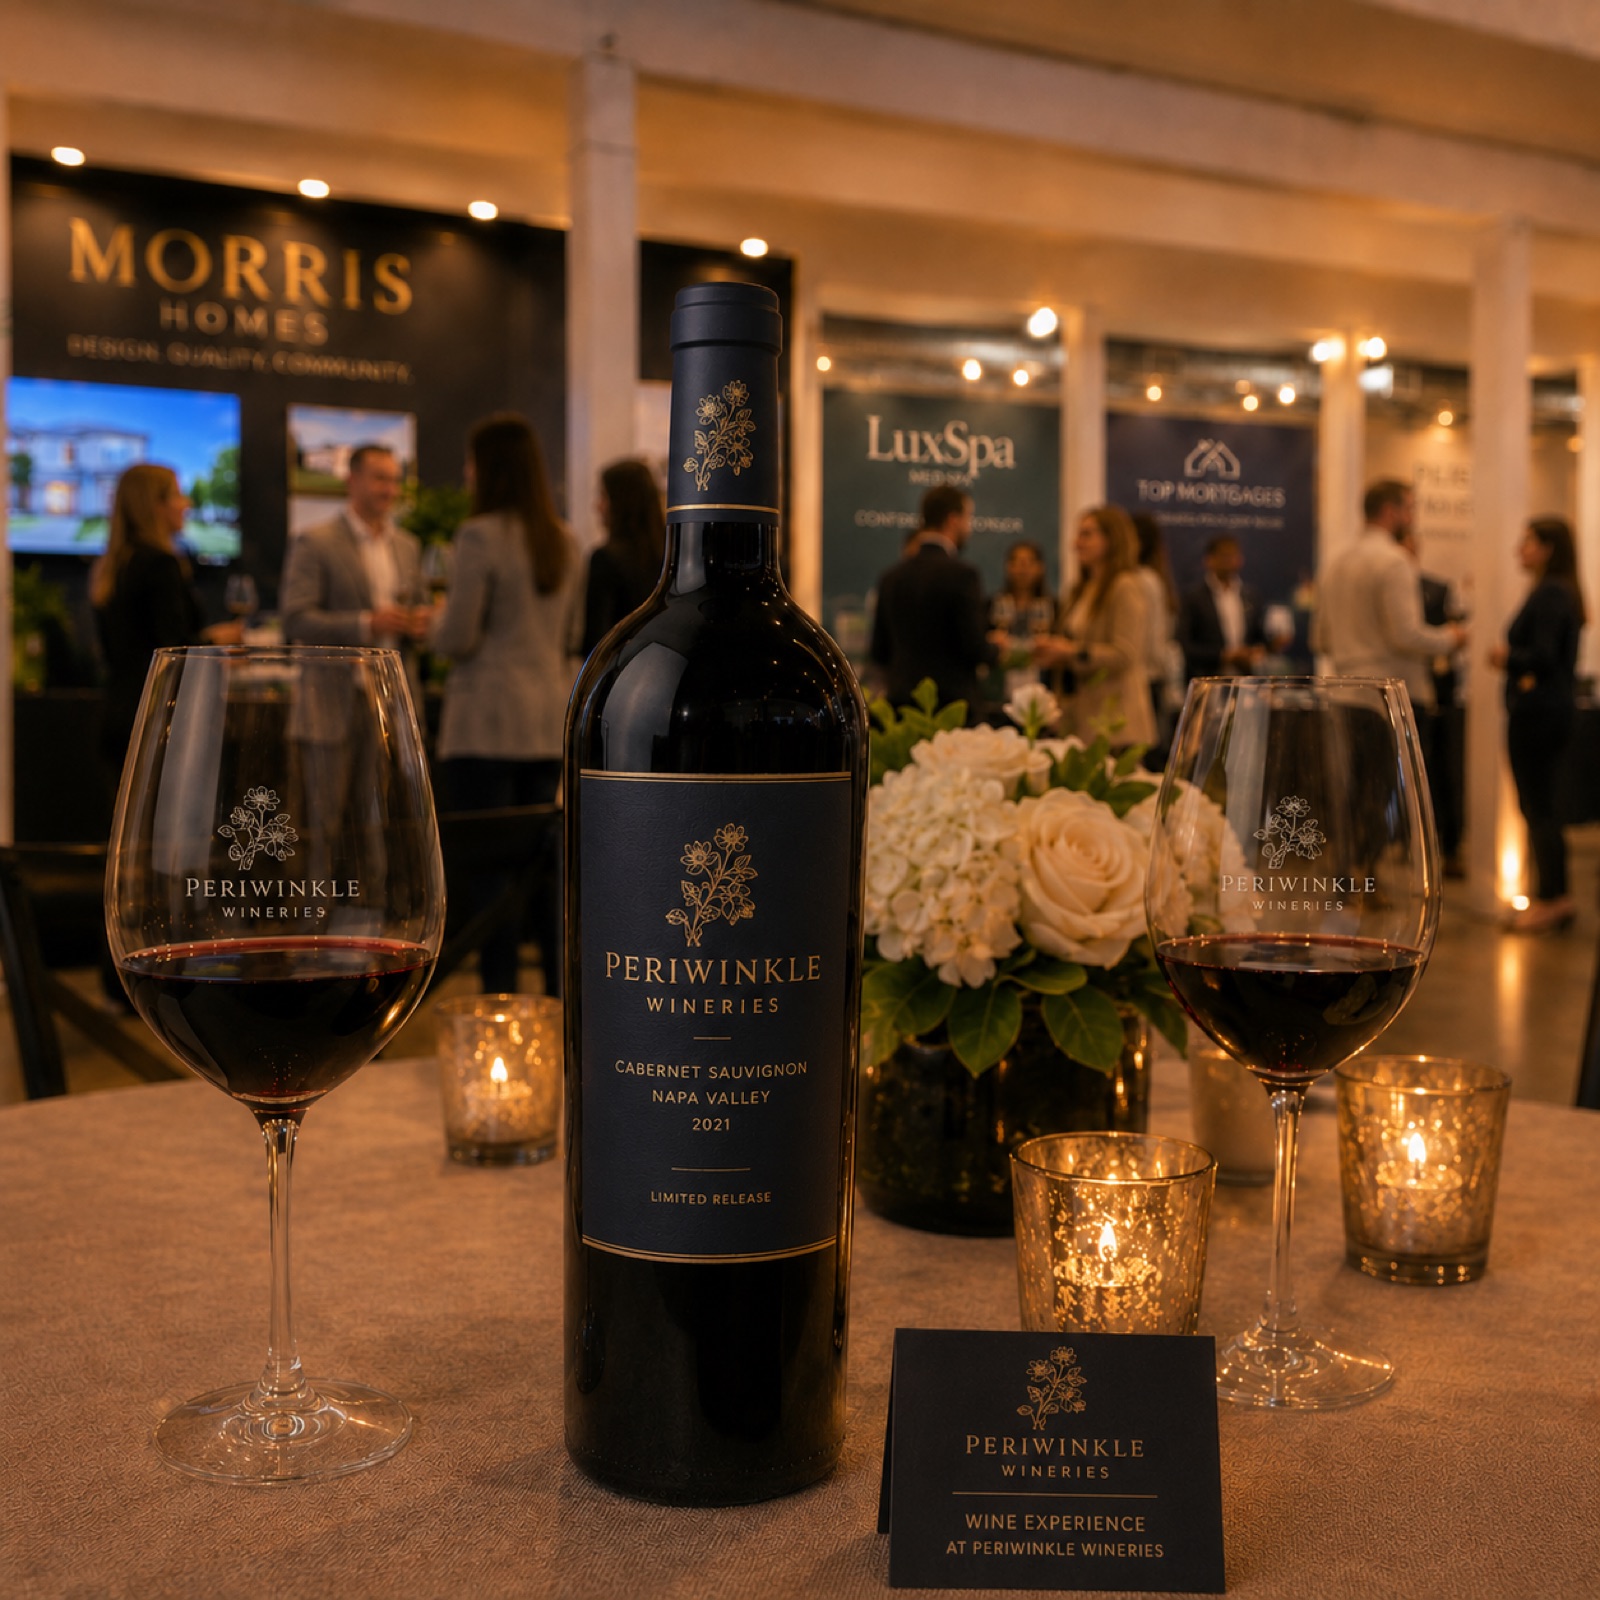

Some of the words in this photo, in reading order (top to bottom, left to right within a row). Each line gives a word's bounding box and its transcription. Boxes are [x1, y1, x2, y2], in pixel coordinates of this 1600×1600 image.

[69, 217, 413, 315] MORRIS
[159, 299, 329, 346] HOMES
[866, 415, 1016, 479] LuxSpa
[1136, 479, 1175, 503] TOP
[1176, 481, 1286, 509] MORTGAGES
[185, 878, 361, 898] PERIWINKLE
[1221, 875, 1376, 893] PERIWINKLE
[222, 906, 326, 918] WINERIES
[1253, 900, 1344, 911] WINERIES
[605, 951, 821, 986] PERIWINKLE
[647, 997, 779, 1014] WINERIES
[614, 1059, 701, 1079] CABERNET
[708, 1061, 808, 1079] SAUVIGNON
[652, 1089, 699, 1105] NAPA
[706, 1090, 771, 1105] VALLEY
[692, 1117, 731, 1132] 2021
[650, 1190, 707, 1205] LIMITED
[712, 1190, 772, 1205] RELEASE
[965, 1434, 1145, 1458] PERIWINKLE
[1001, 1464, 1110, 1480] WINERIES
[965, 1513, 1017, 1531] WINE
[1025, 1514, 1146, 1532] EXPERIENCE
[946, 1540, 967, 1555] AT
[972, 1541, 1076, 1556] PERIWINKLE
[1081, 1542, 1165, 1558] WINERIES
